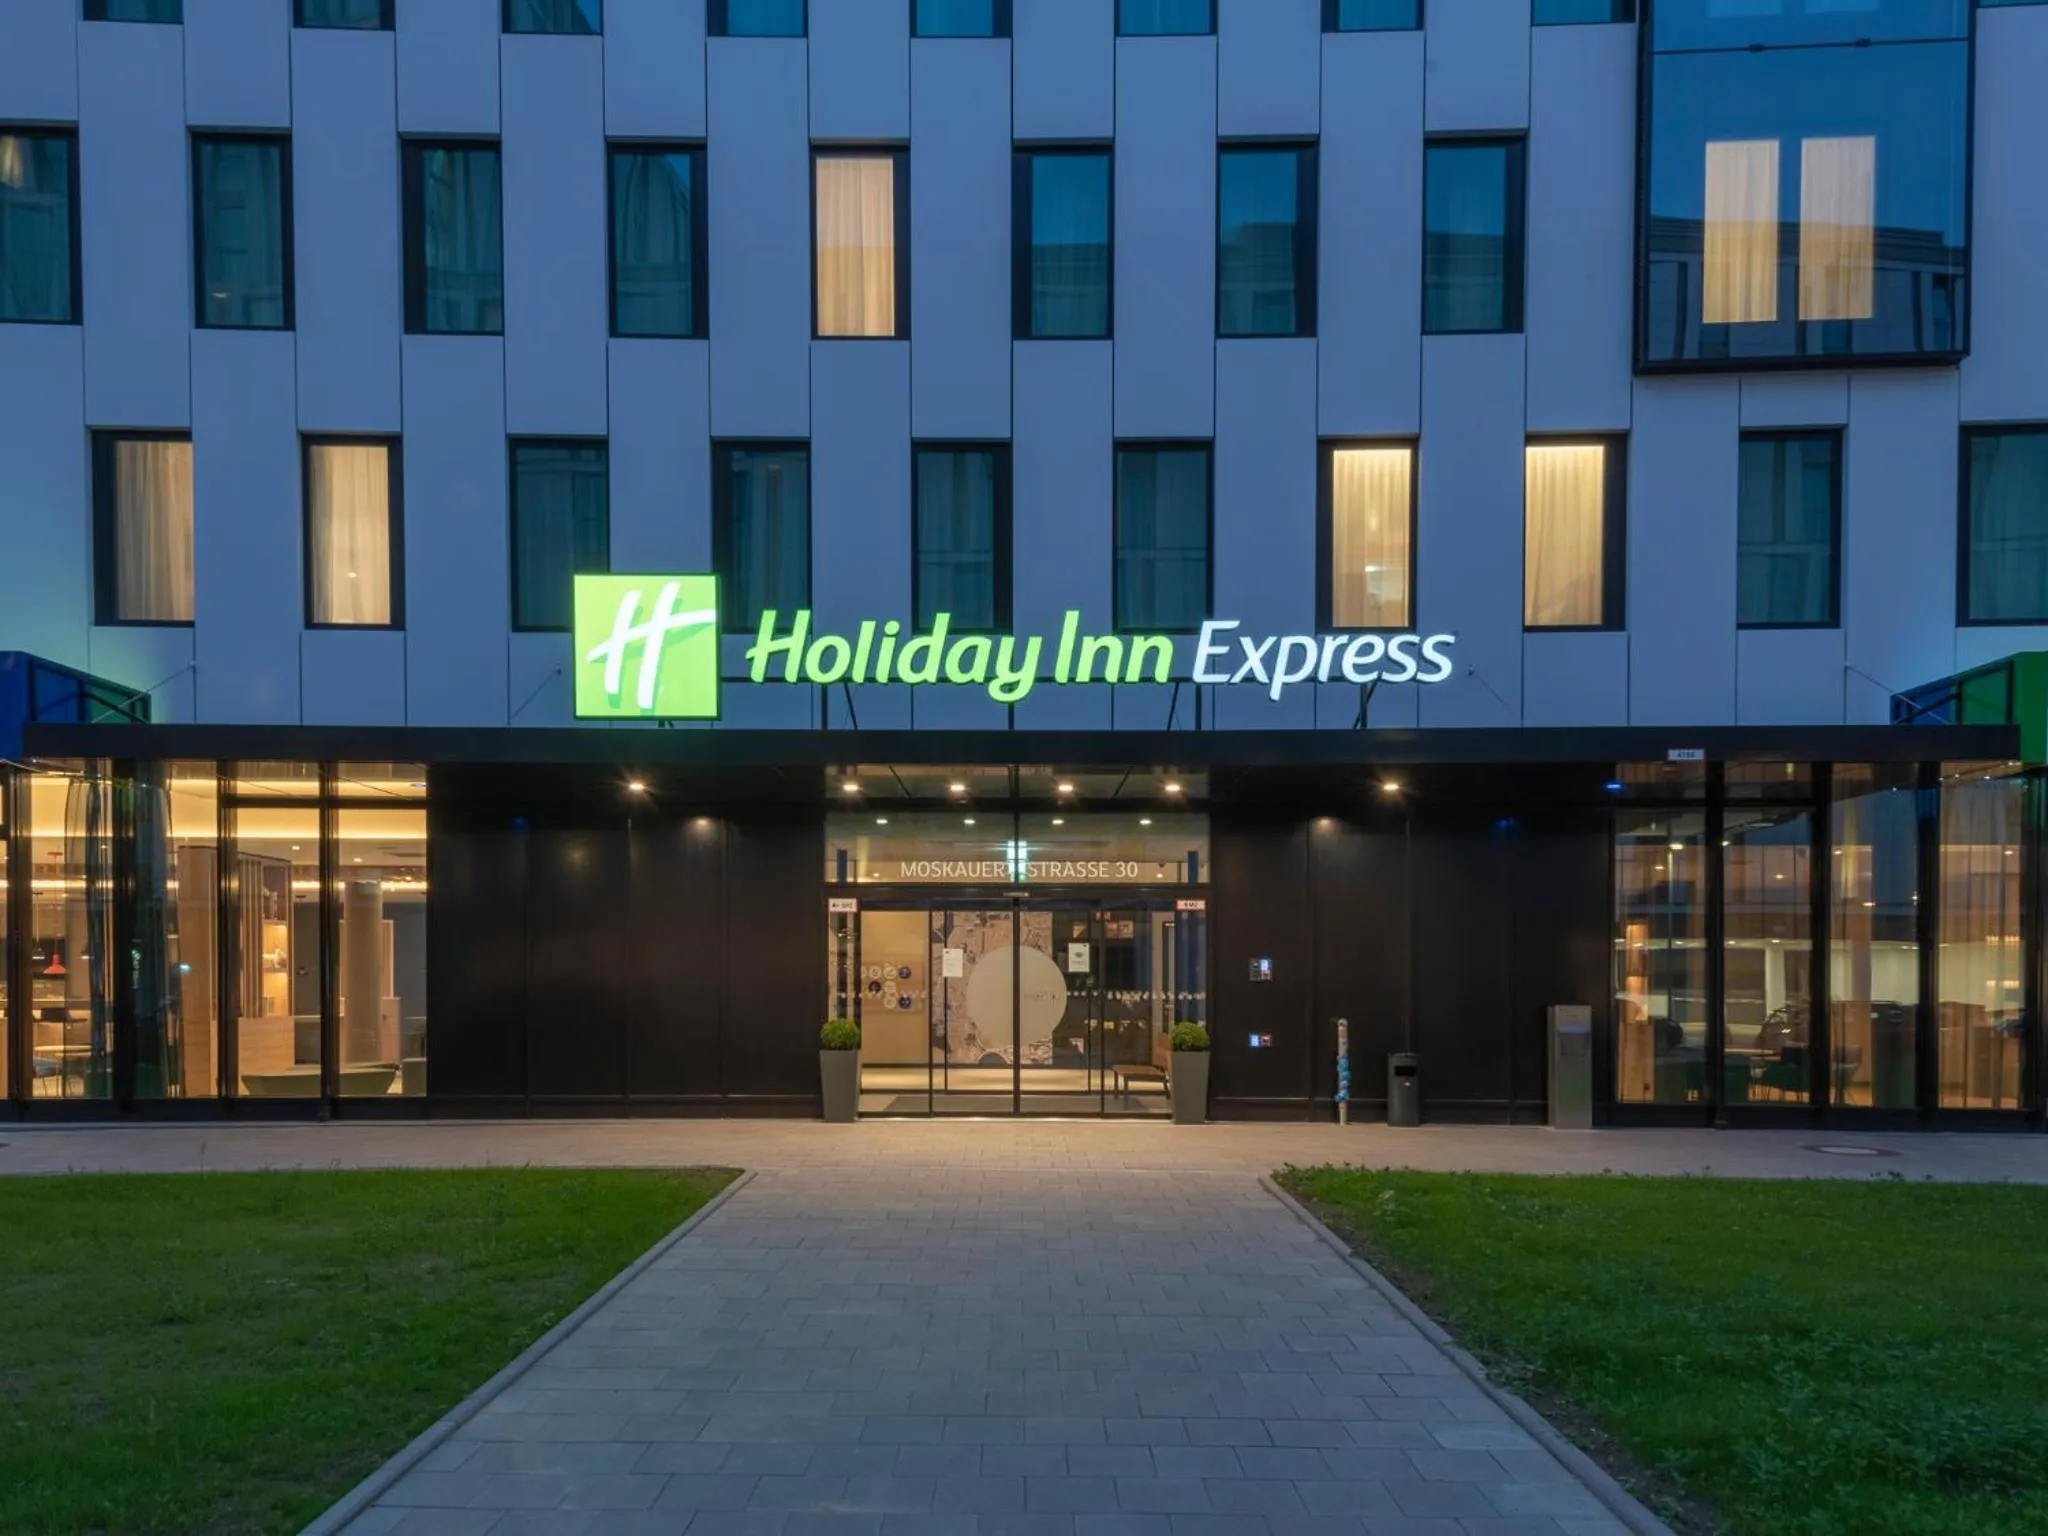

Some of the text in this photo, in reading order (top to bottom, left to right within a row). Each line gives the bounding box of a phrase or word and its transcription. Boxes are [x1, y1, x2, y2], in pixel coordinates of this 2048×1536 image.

[745, 609, 1455, 702] Holiday Inn Express
[899, 861, 1139, 878] MOSKAUER STRASSE 30
